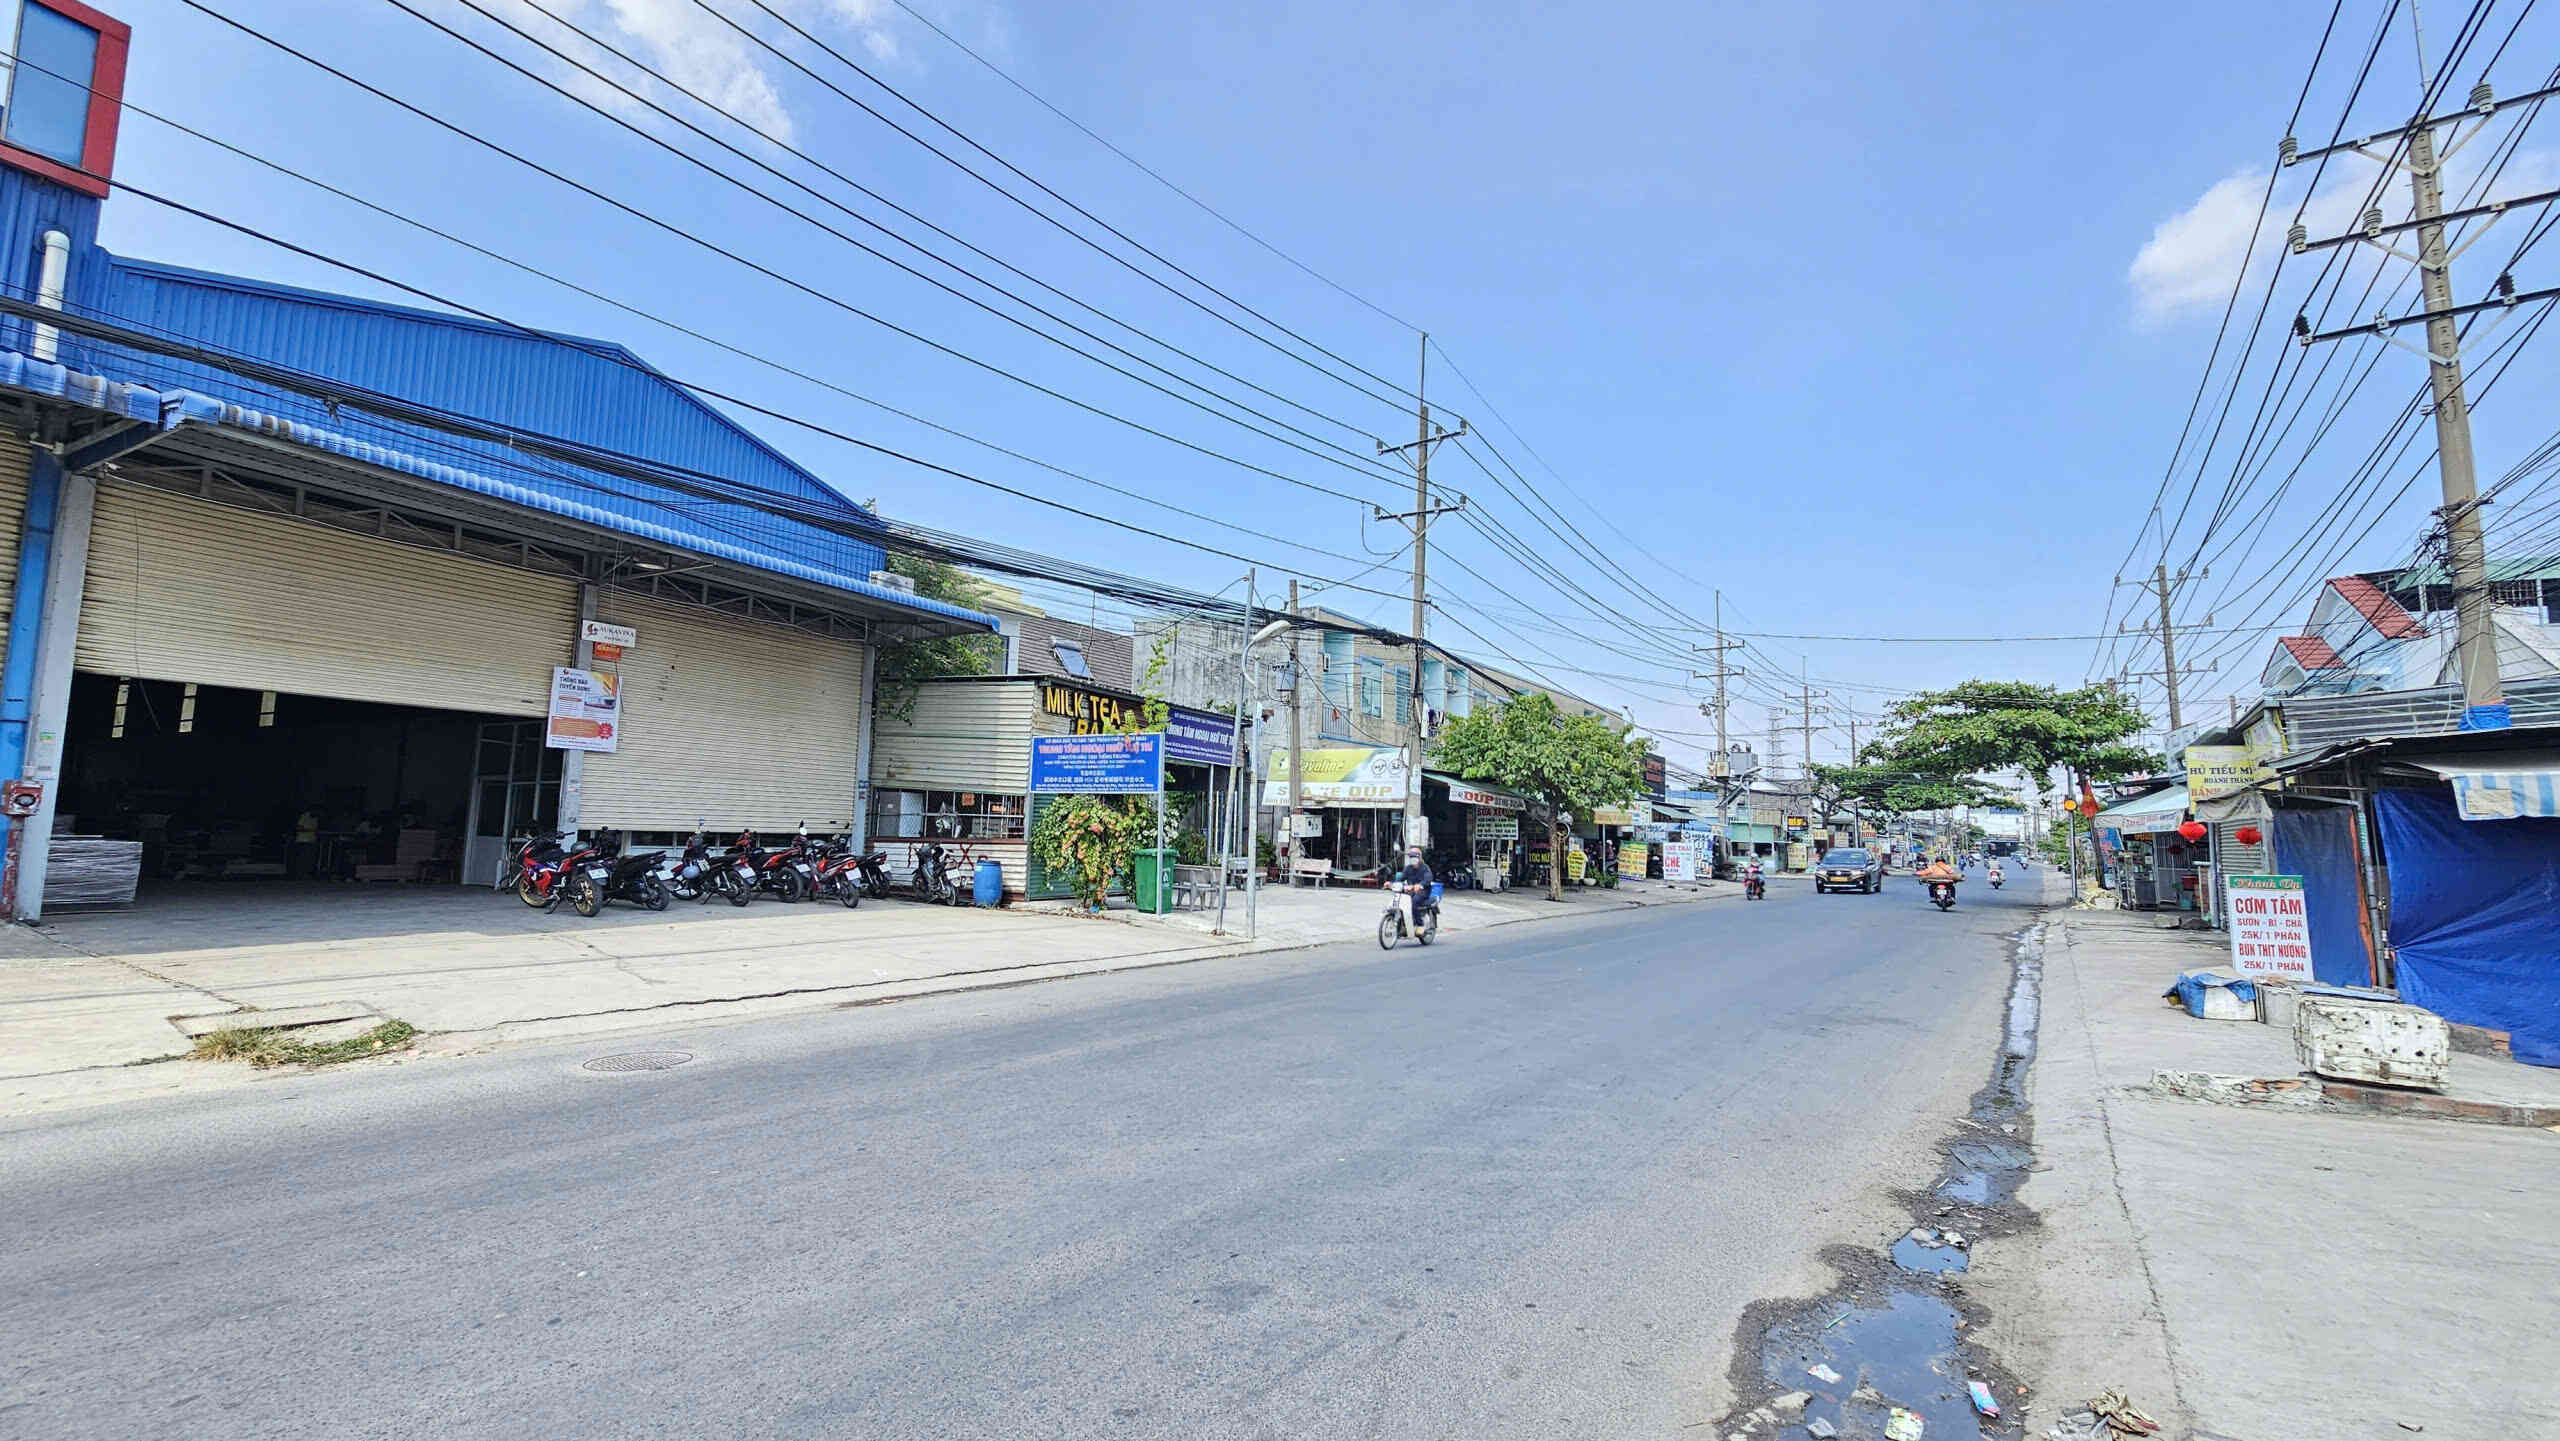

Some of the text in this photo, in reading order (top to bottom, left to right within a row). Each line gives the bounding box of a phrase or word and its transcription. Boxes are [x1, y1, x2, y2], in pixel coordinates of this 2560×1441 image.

[1047, 686, 1121, 725] MILK TEA
[2235, 893, 2302, 915] CƠM TẤM
